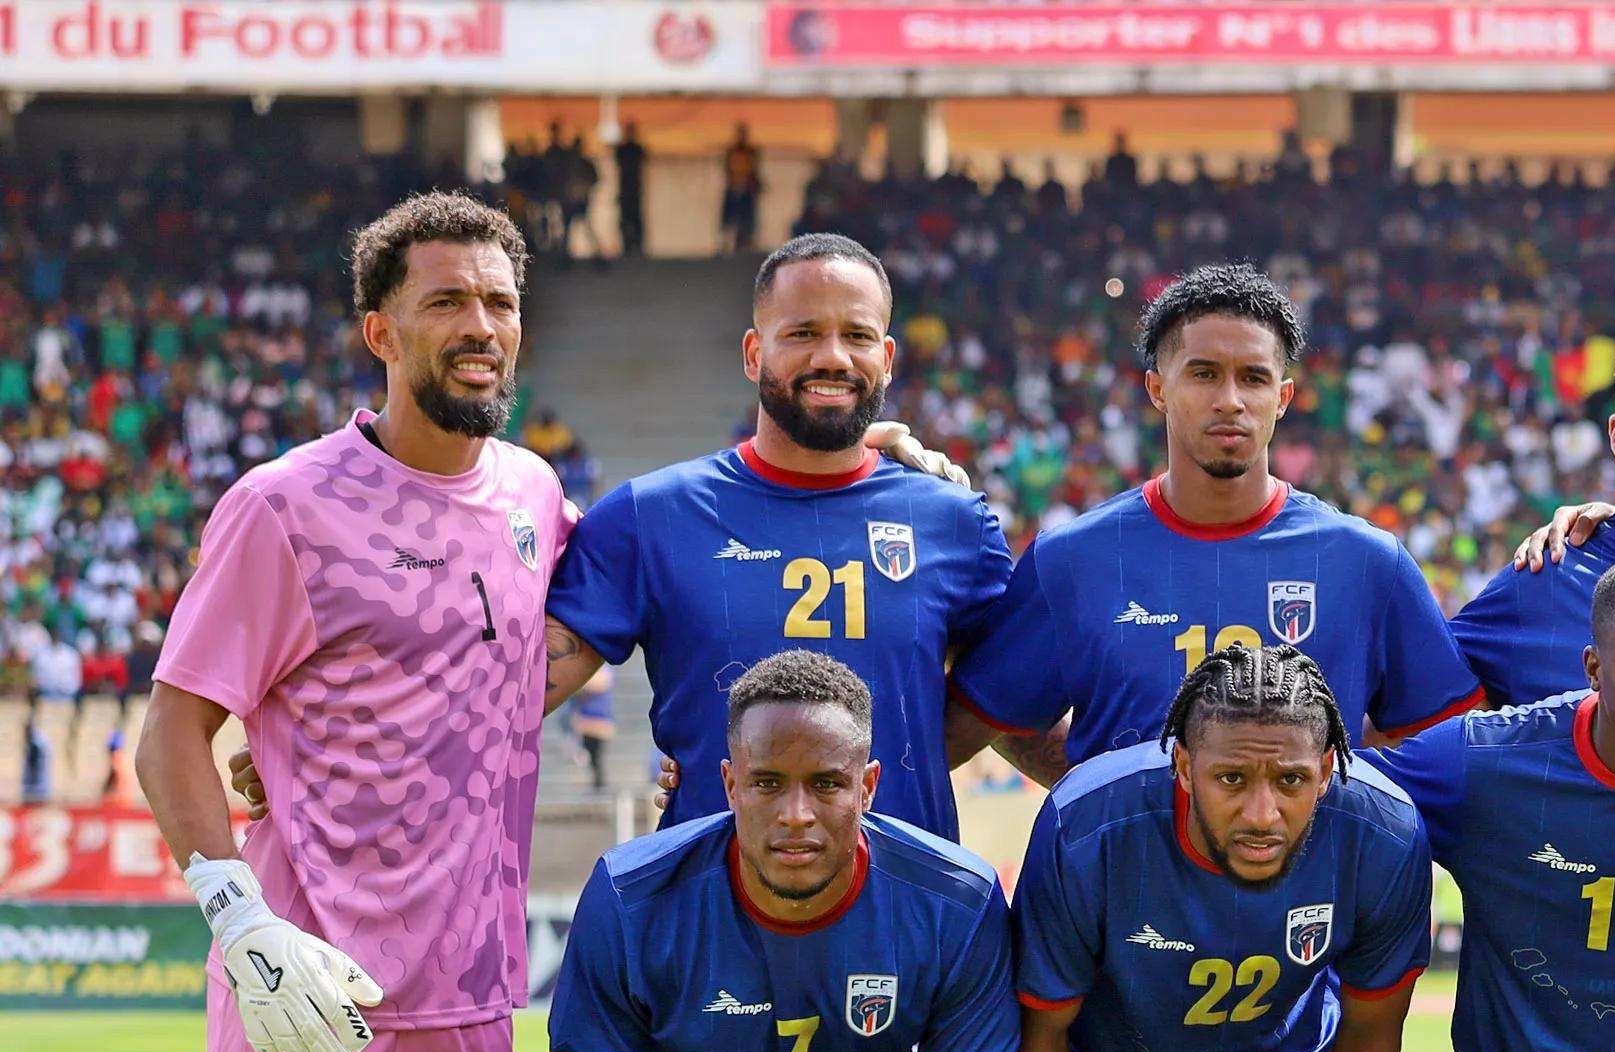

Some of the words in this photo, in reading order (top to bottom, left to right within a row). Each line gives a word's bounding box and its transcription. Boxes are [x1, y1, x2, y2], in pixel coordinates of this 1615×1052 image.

[52, 2, 152, 58] du
[181, 0, 504, 58] Football
[904, 13, 1198, 51] Supporter
[1337, 13, 1437, 50] des
[1453, 8, 1579, 53] Lions
[871, 526, 907, 536] FCF
[736, 549, 782, 561] tempo
[406, 558, 445, 570] tempo
[1272, 584, 1311, 594] FCF
[783, 557, 866, 640] 21
[471, 571, 497, 641] 1
[1135, 613, 1179, 625] tempo
[1550, 859, 1597, 873] tempo
[1290, 907, 1330, 921] FCF
[1150, 938, 1195, 952] tempo
[851, 978, 893, 989] FCF
[1183, 955, 1281, 1026] 22
[727, 1002, 773, 1015] tempo
